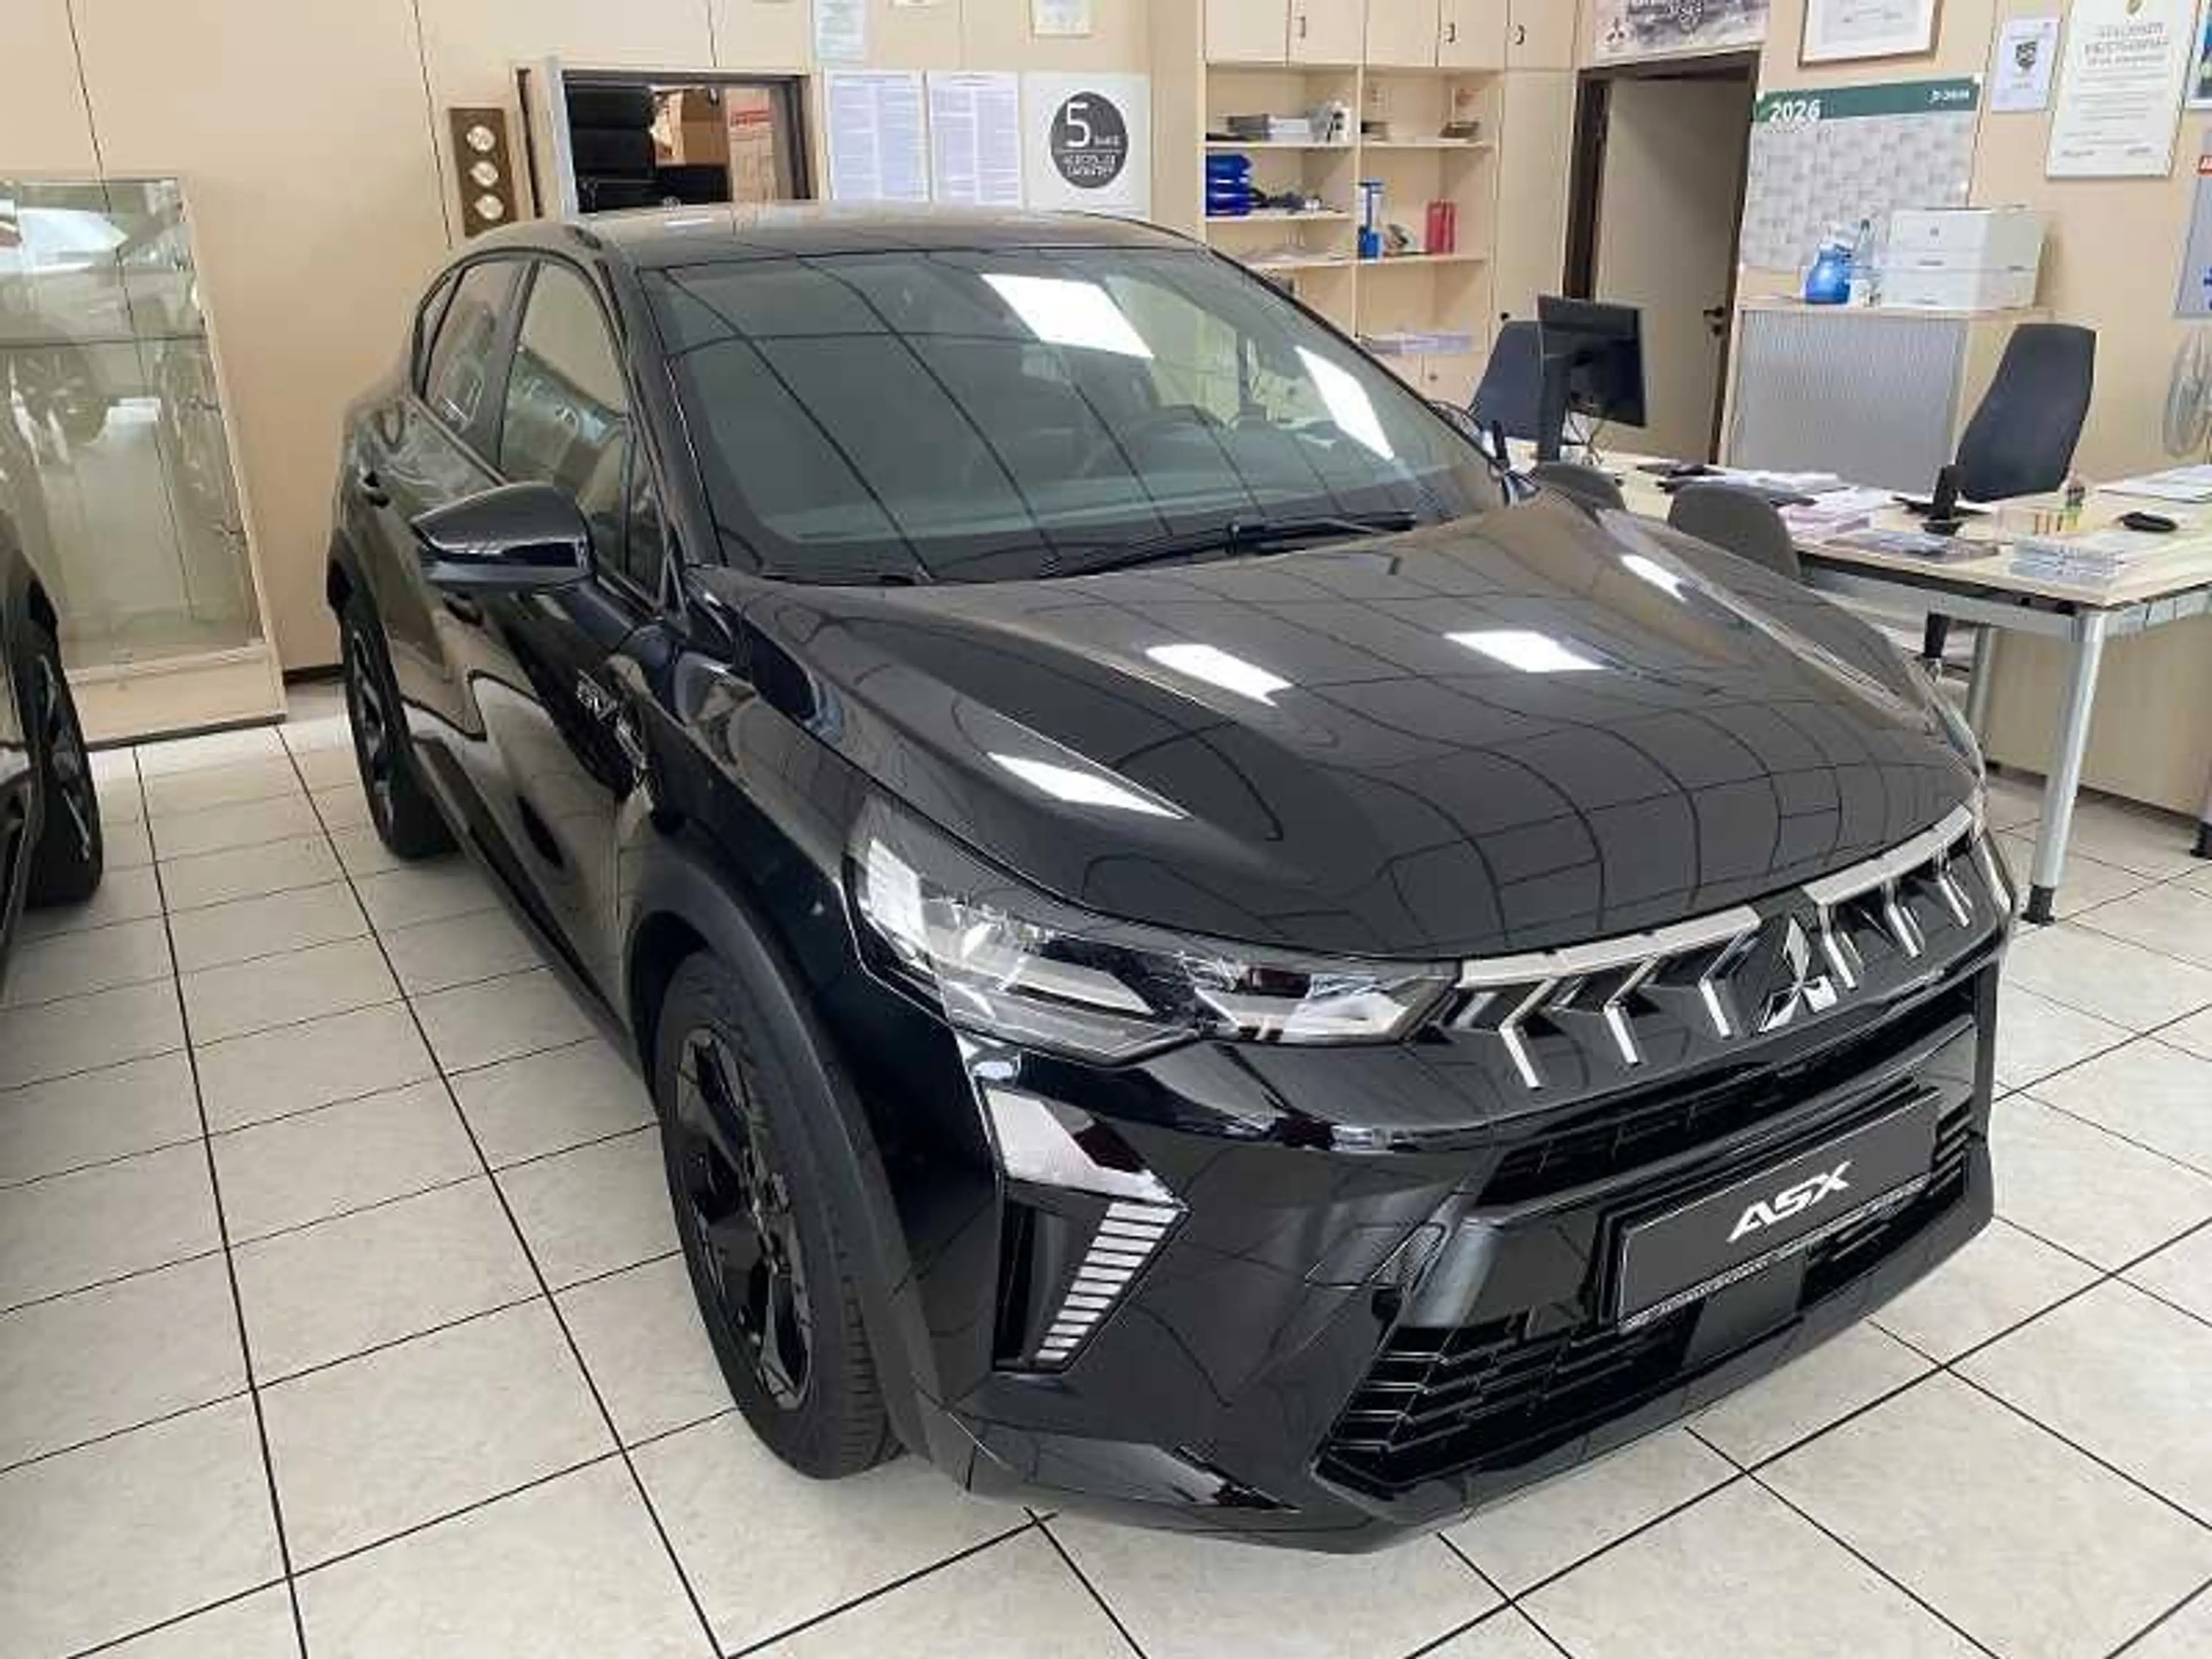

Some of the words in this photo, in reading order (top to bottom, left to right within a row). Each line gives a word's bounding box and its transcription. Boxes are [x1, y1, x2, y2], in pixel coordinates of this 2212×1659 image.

[1067, 102, 1090, 147] 5
[1770, 100, 1820, 123] 2026
[1726, 1160, 1851, 1242] ASX
